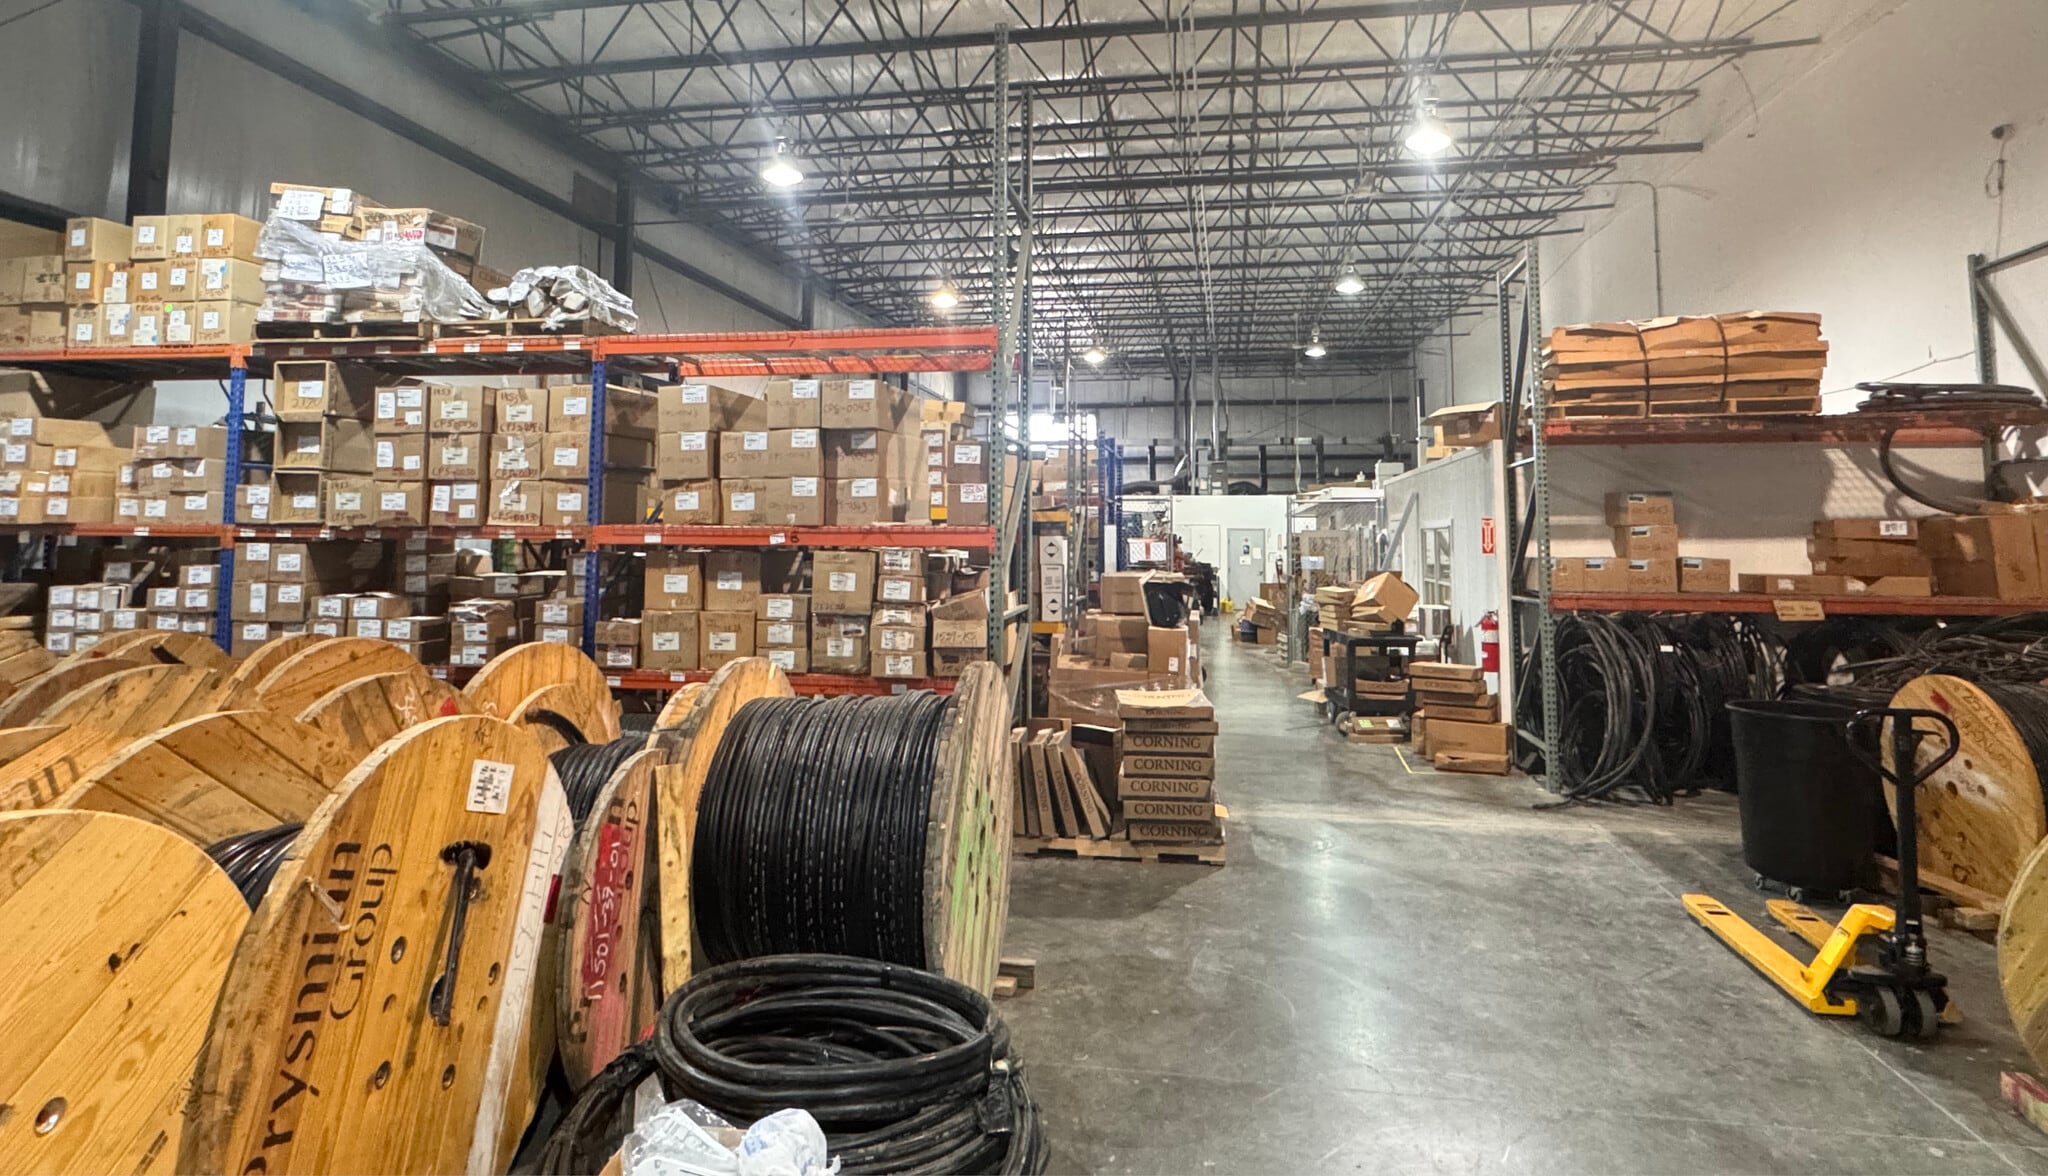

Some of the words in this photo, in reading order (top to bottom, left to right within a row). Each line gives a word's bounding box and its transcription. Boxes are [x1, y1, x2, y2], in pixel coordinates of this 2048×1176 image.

[1133, 735, 1201, 749] CORNING
[1134, 758, 1202, 772] CORNING
[1130, 780, 1199, 794] CORNING
[1134, 803, 1203, 817] CORNING
[1139, 823, 1210, 837] CORNING
[330, 843, 397, 1020] Group
